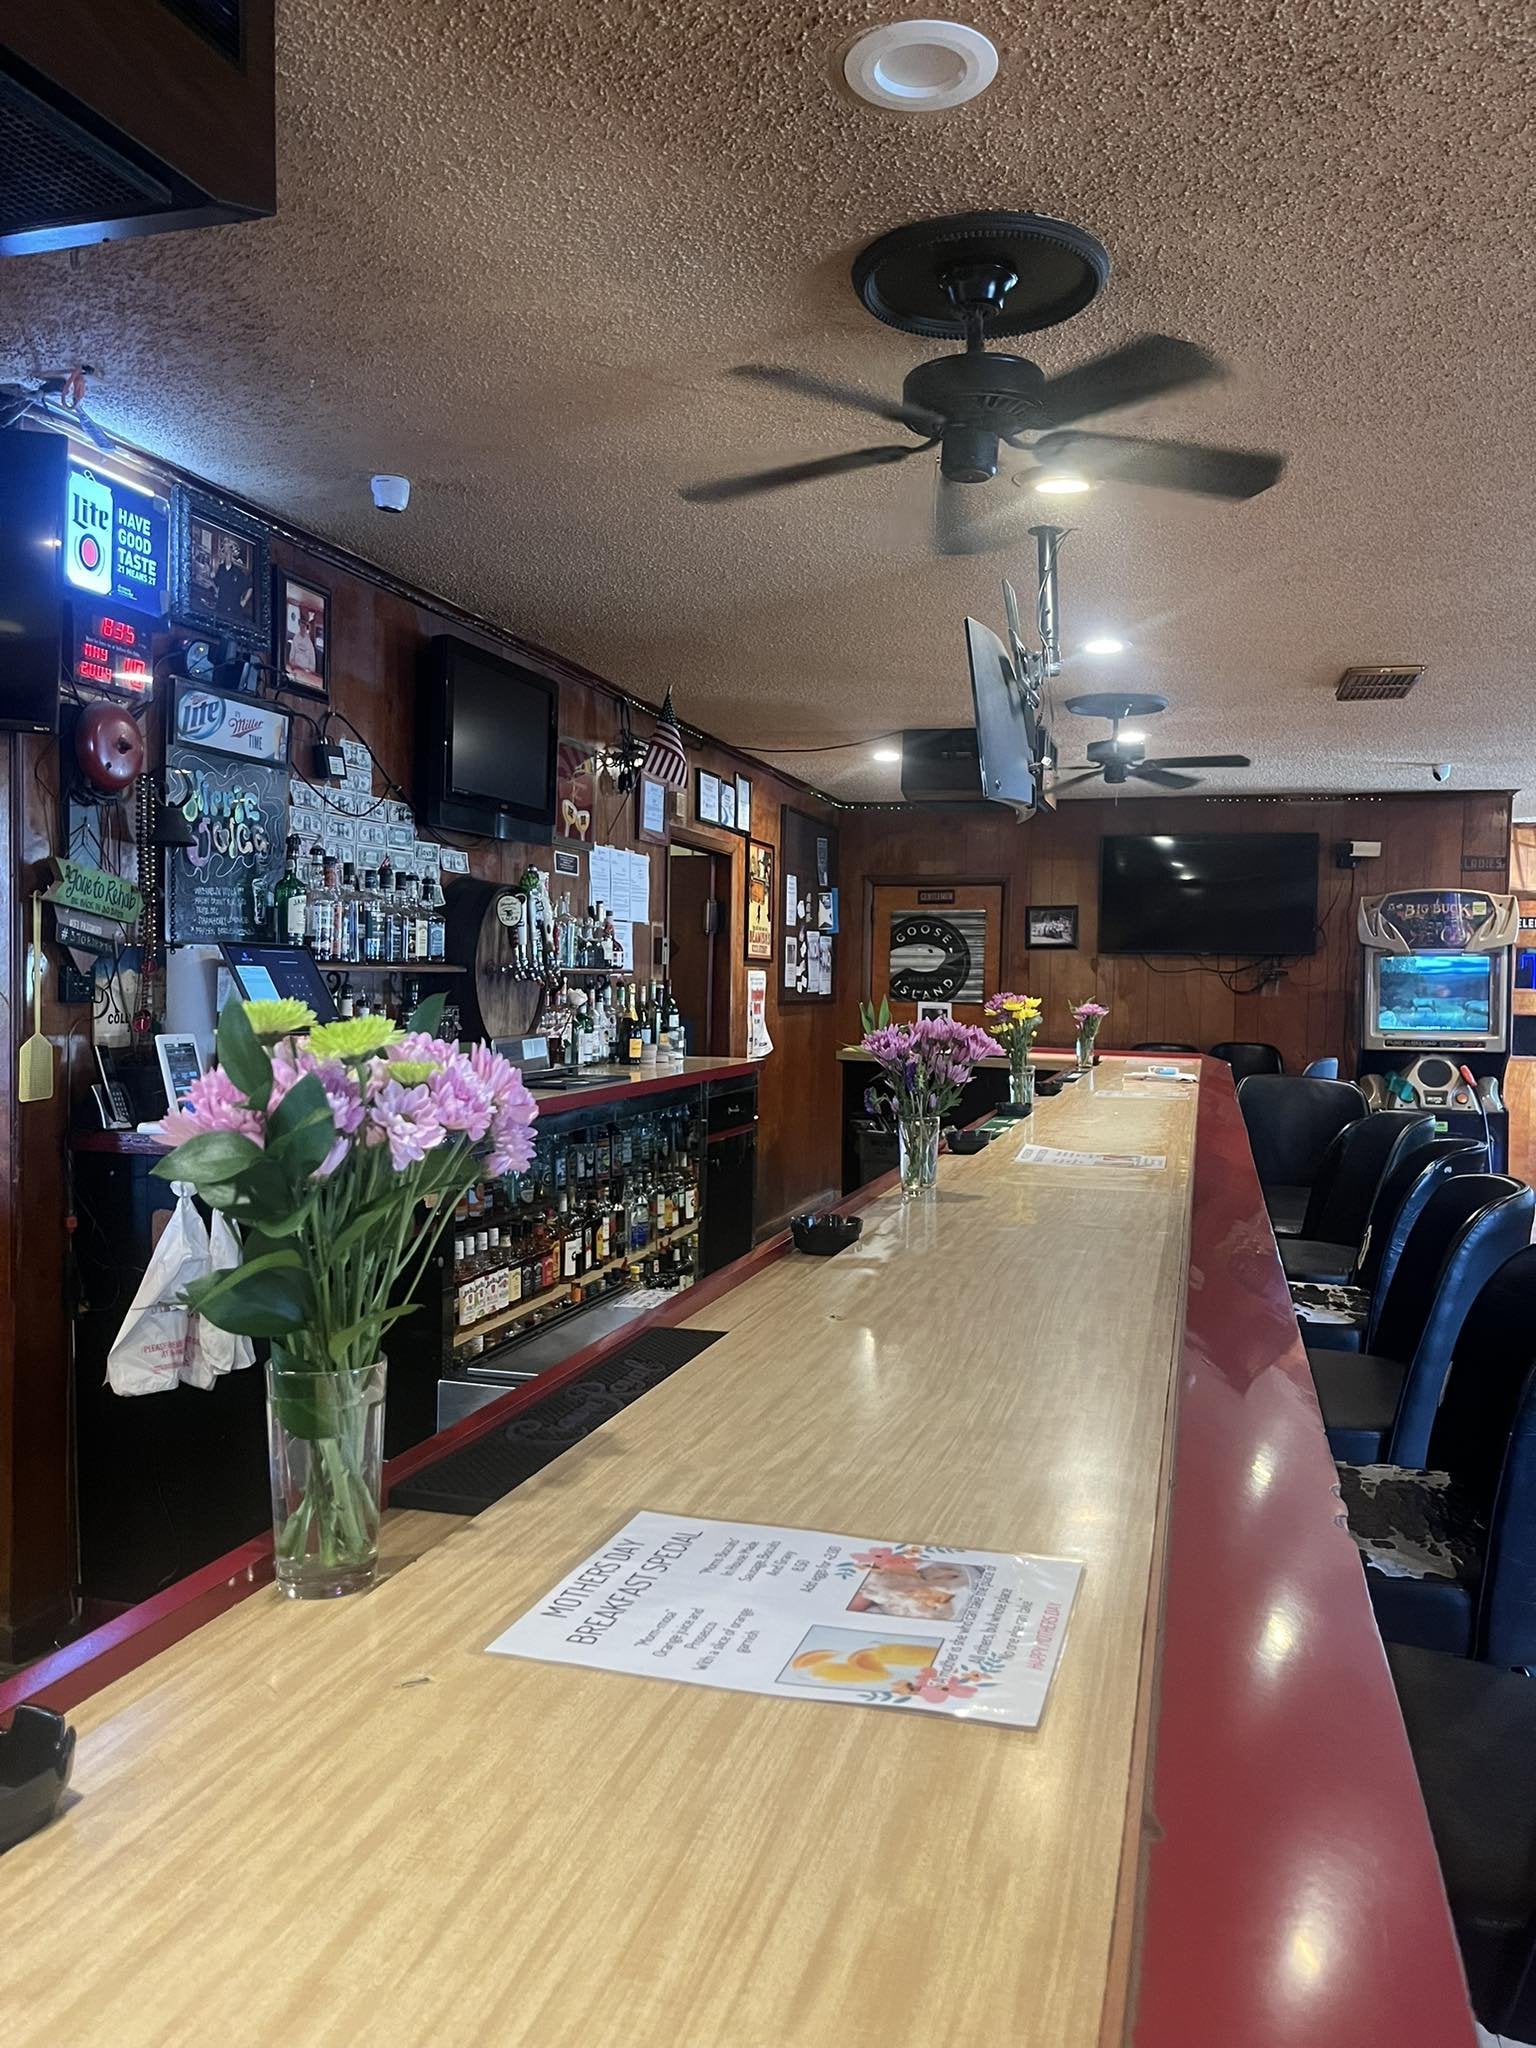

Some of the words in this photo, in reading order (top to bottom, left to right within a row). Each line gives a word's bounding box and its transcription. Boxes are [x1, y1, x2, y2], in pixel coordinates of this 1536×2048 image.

[72, 493, 109, 530] Lite
[118, 507, 151, 537] HAVE
[118, 528, 152, 555] GOOD
[117, 564, 125, 573] 21
[126, 565, 147, 583] MEANS
[148, 576, 156, 586] 21
[118, 546, 157, 577] TASTE
[182, 701, 220, 736] Lite
[229, 718, 264, 738] Miller
[248, 734, 262, 751] TIME
[105, 880, 137, 911] Rehab
[1404, 904, 1430, 918] BIG
[1433, 902, 1472, 917] BUCK
[896, 924, 953, 945] GOOSE
[895, 979, 954, 1000] ISLAND
[541, 1561, 621, 1618] MOTHERS
[602, 1537, 645, 1562] DAY
[566, 1572, 657, 1645] BREAKFAST
[640, 1531, 703, 1573] SPECIAL
